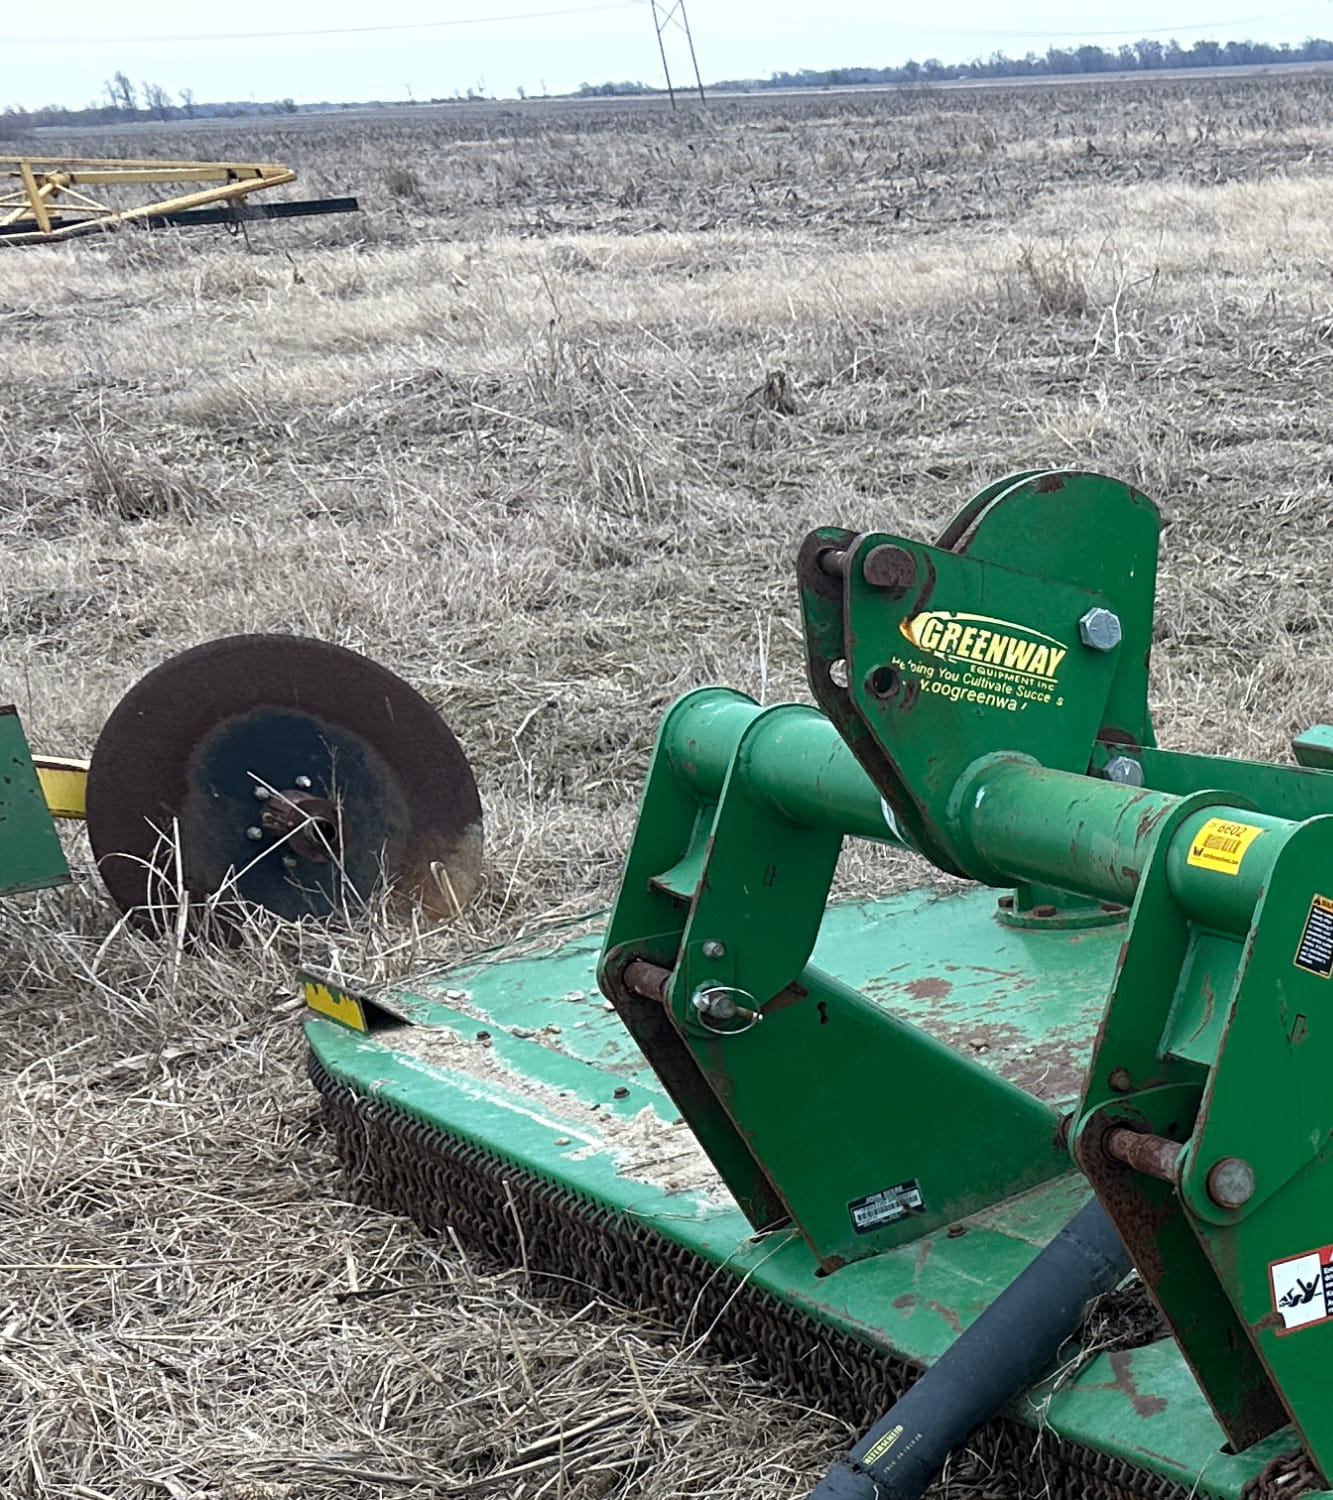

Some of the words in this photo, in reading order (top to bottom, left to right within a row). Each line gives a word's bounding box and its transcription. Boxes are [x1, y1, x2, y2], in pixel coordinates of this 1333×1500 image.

[920, 618, 1067, 677] GREENWAY
[939, 667, 960, 682] You
[963, 672, 1013, 695] Cultivate
[1016, 685, 1064, 706] Succes
[970, 664, 1035, 686] EQUIPMENT
